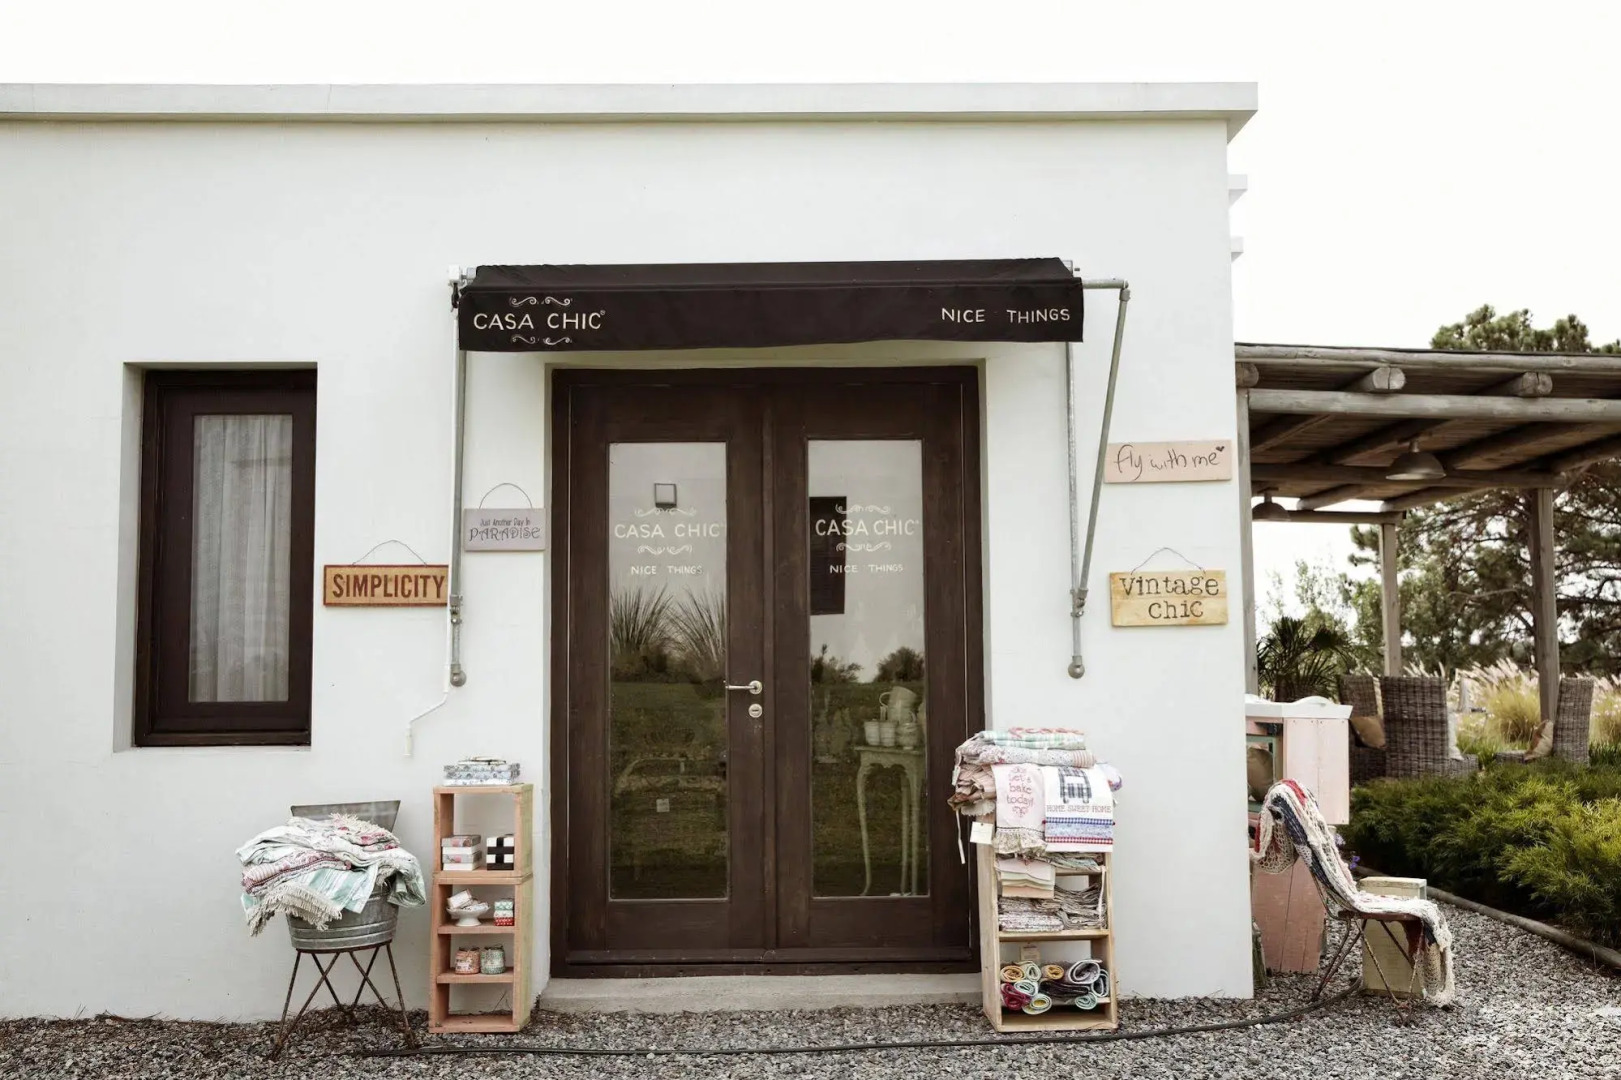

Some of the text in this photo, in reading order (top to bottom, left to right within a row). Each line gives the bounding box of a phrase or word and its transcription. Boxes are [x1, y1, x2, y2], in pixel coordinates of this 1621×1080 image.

[473, 313, 534, 331] CASA
[941, 307, 1071, 323] NICE THINGS
[1150, 448, 1187, 470] with
[1192, 452, 1220, 468] me
[614, 523, 721, 539] CASA CHIC
[815, 519, 869, 536] CASA
[630, 565, 704, 575] NICE THINGS
[829, 564, 904, 574] NICE THINGS
[332, 573, 445, 598] SIMPLICITY
